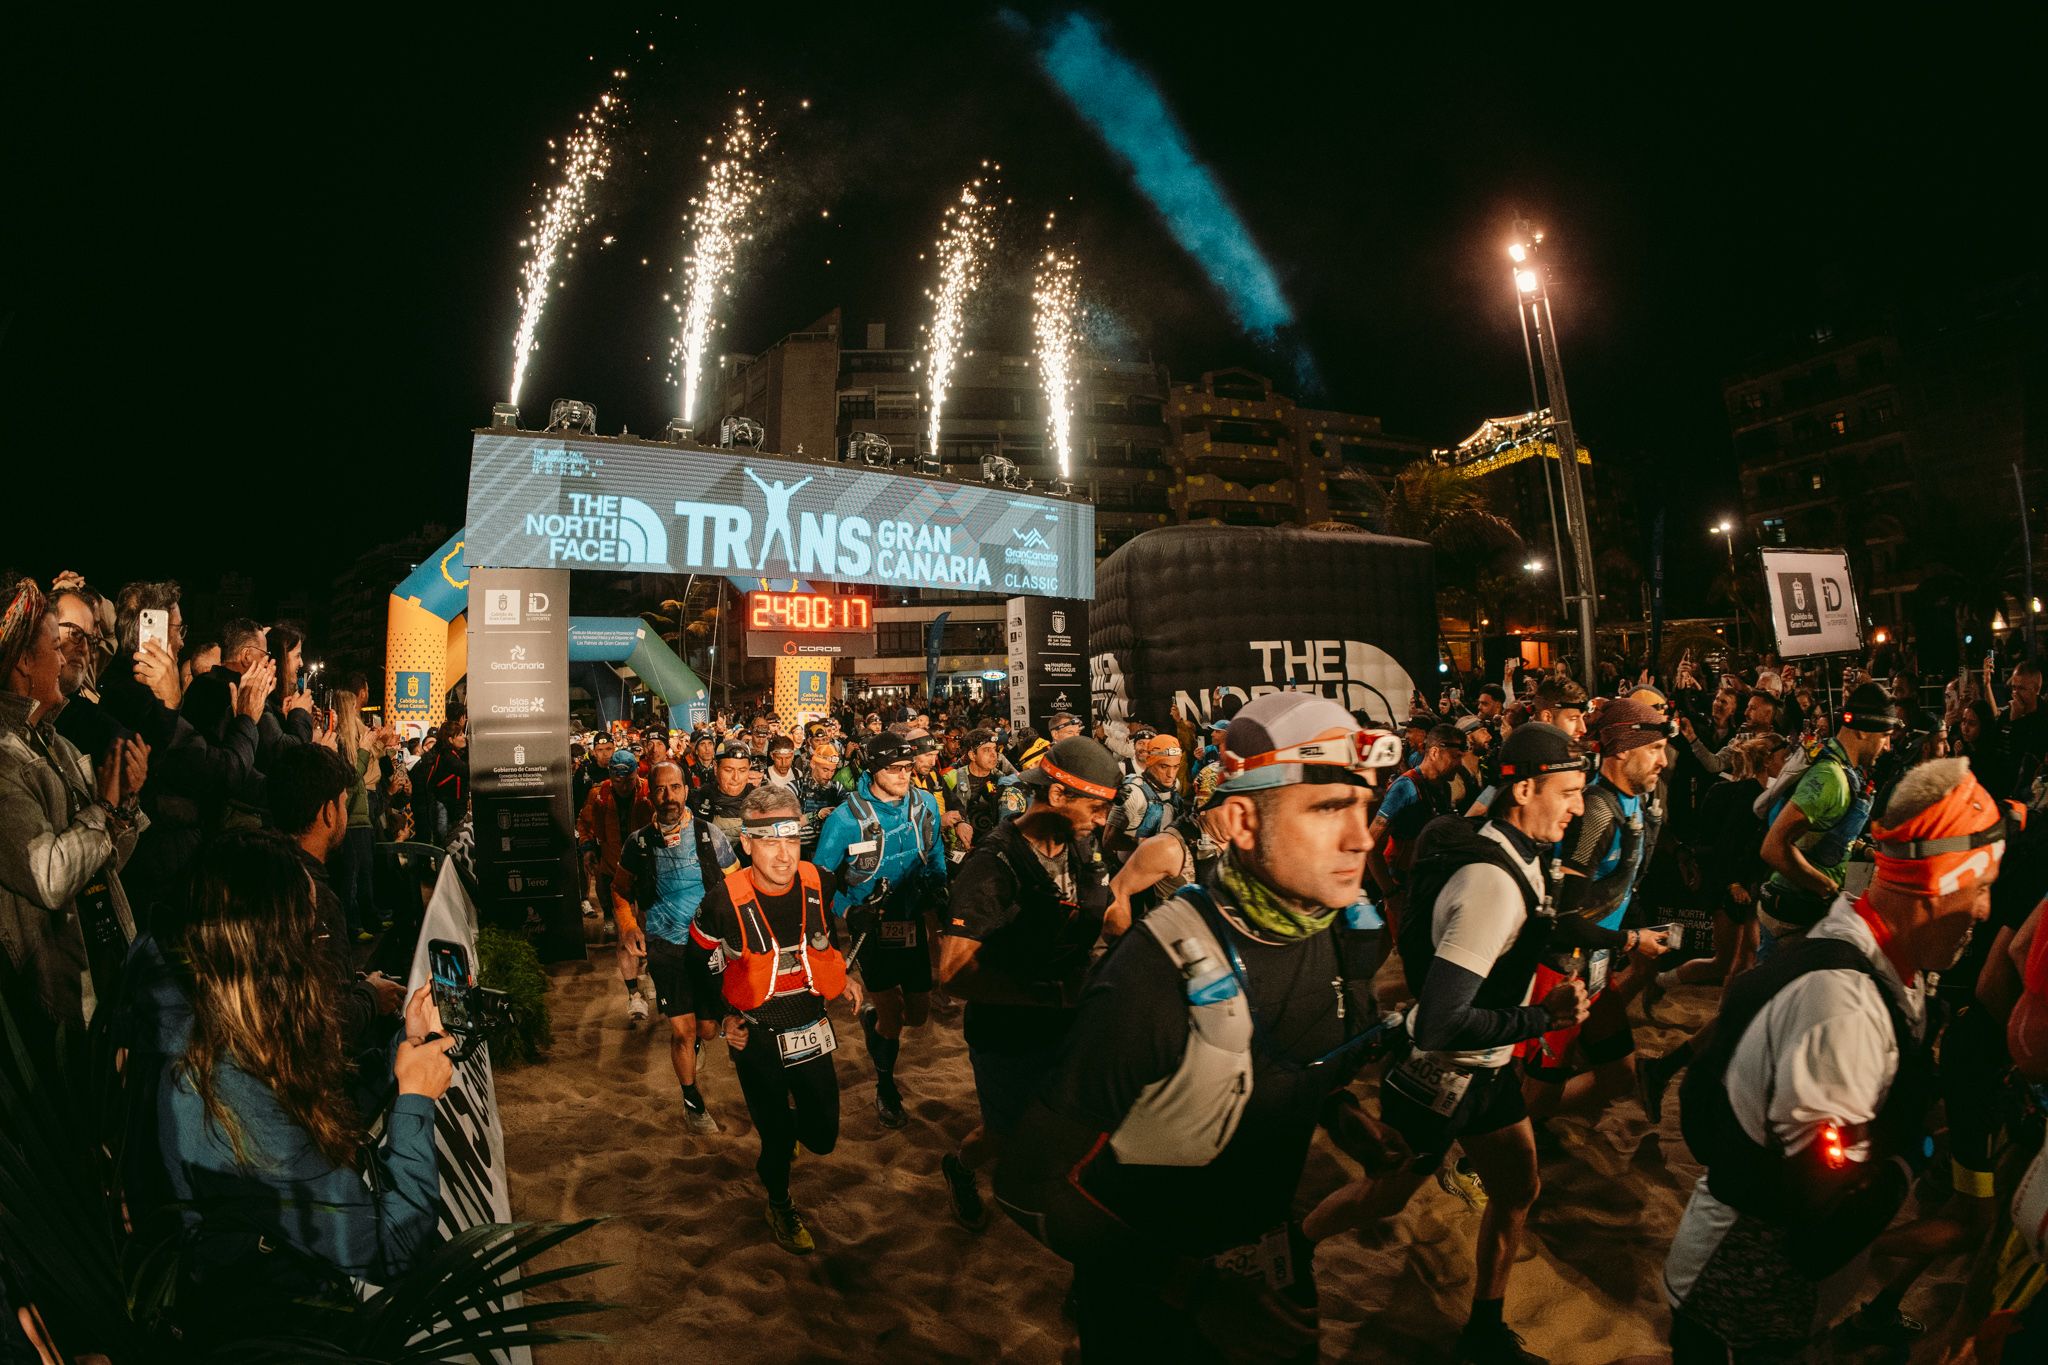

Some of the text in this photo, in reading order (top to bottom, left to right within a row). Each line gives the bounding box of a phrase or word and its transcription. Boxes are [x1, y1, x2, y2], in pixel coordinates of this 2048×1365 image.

[568, 492, 618, 516] THE
[526, 514, 618, 538] NORTH
[878, 520, 951, 554] GRAN
[550, 538, 616, 562] FACE
[1006, 548, 1058, 562] GranCanaria
[878, 550, 992, 586] CANARIA
[1005, 574, 1058, 590] CLASSIC
[754, 594, 866, 628] 24:00:17
[1790, 620, 1802, 628] Gran
[490, 662, 545, 670] GranCanaria
[1249, 640, 1344, 682] THE
[492, 705, 530, 713] Canarias
[510, 697, 529, 706] Islas
[790, 1032, 817, 1050] 716
